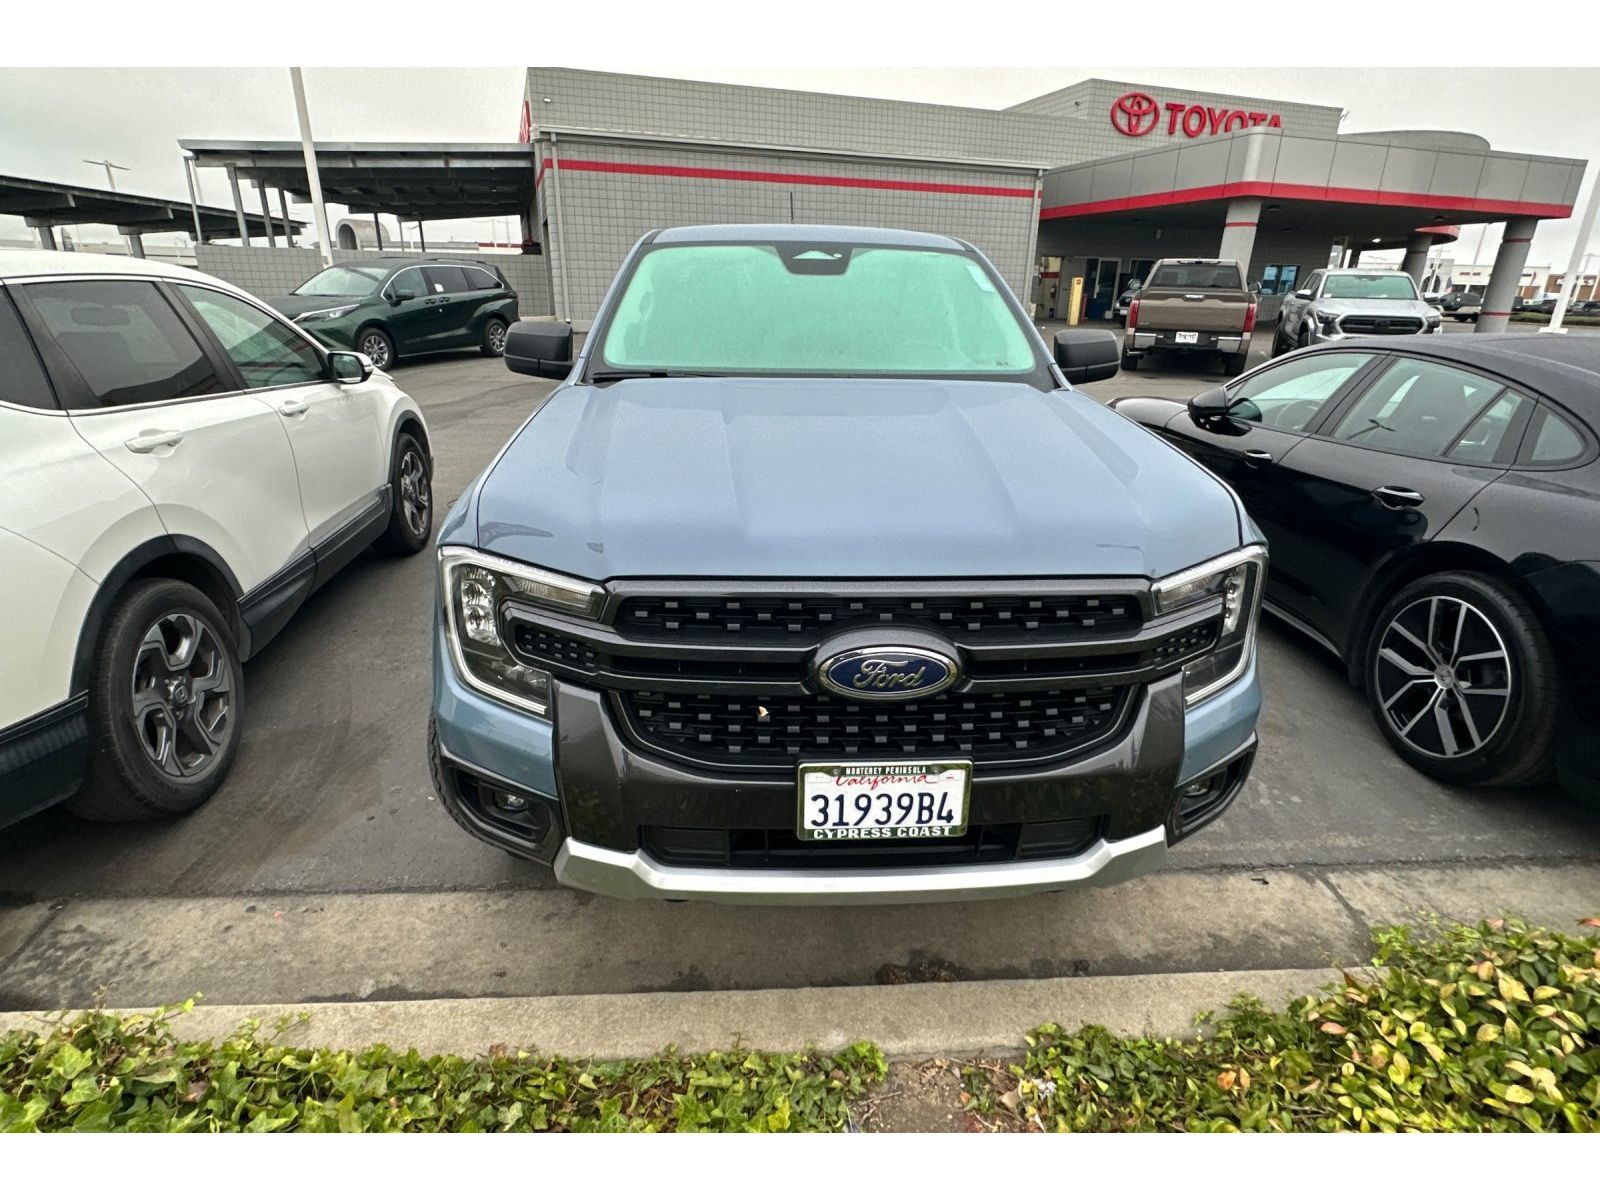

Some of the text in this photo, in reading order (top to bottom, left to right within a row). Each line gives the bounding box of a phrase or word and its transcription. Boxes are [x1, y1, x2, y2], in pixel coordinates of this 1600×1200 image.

[853, 659, 926, 689] Ford
[845, 765, 927, 775] MONTEREY PENINSULA
[834, 773, 939, 790] California
[810, 791, 954, 827] 31939B4
[813, 825, 953, 840] CYPRESS COAST
